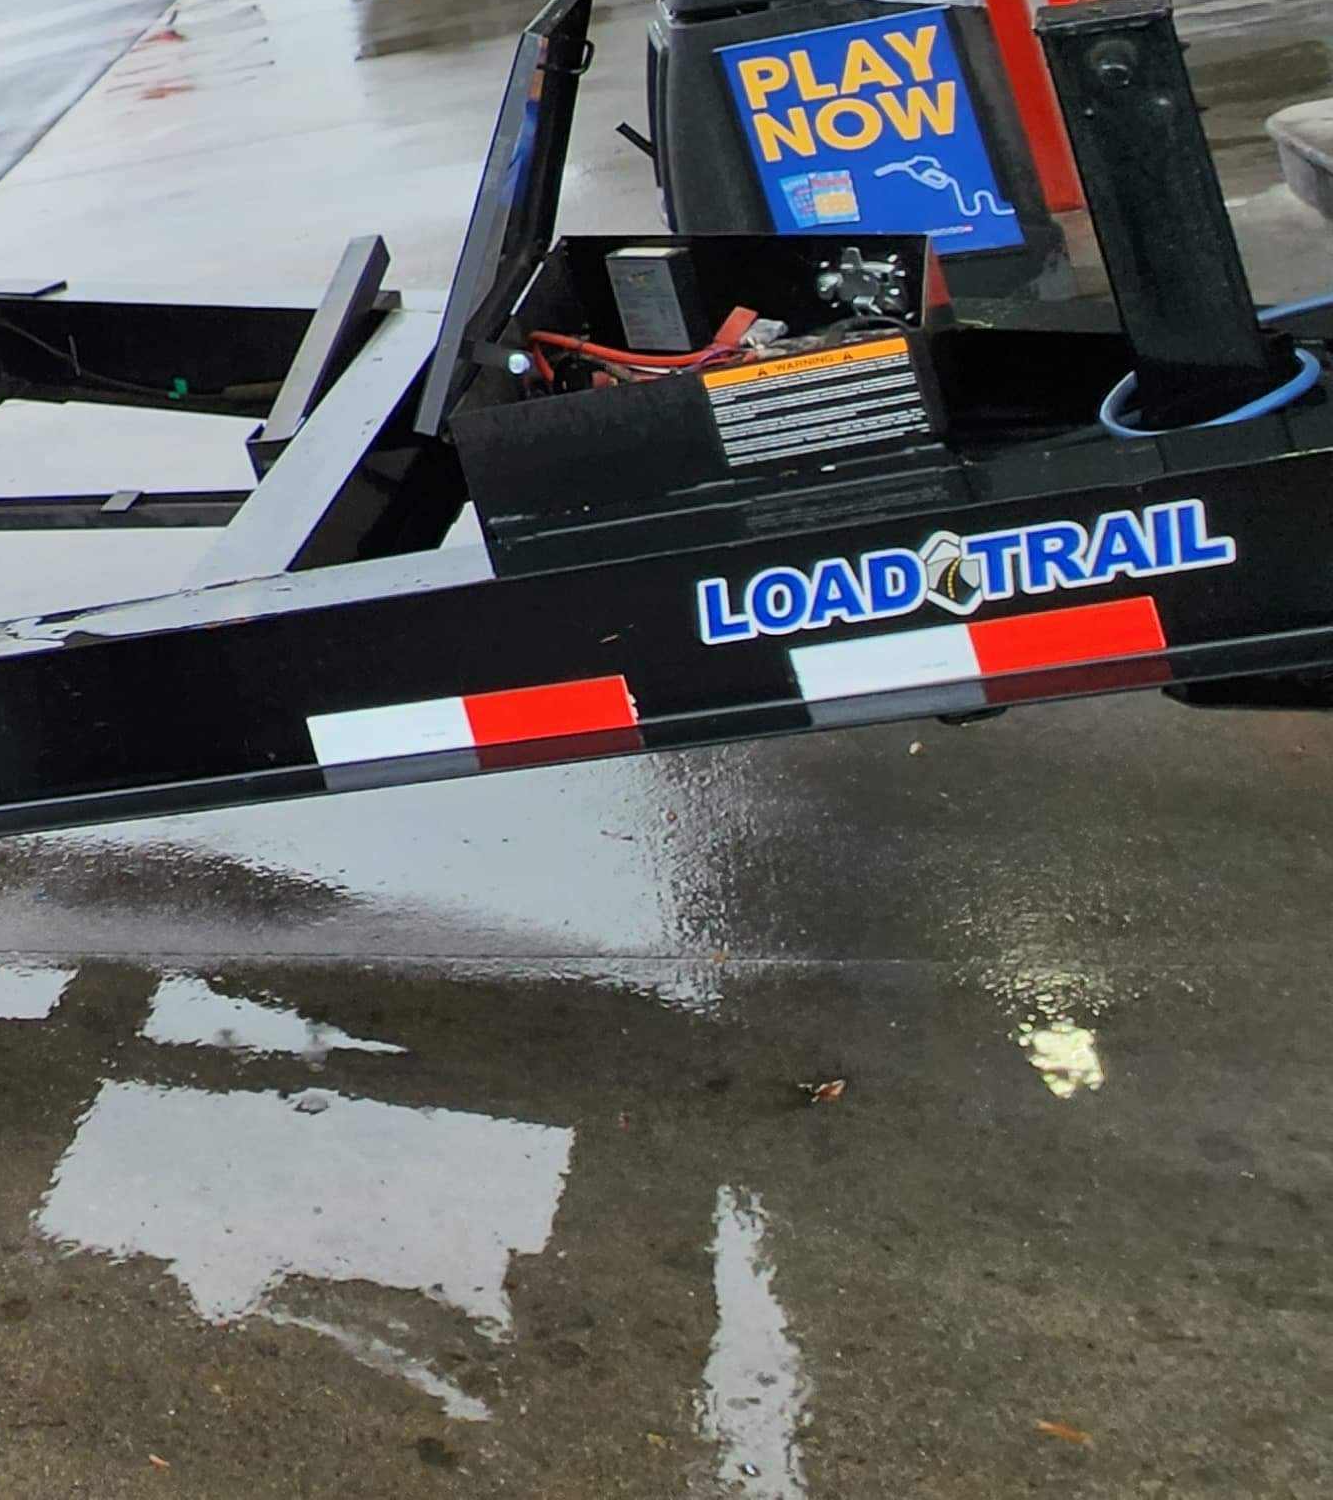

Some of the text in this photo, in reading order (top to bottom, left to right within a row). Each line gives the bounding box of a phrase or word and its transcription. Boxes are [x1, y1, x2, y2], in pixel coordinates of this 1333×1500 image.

[738, 25, 937, 110] PLAY
[753, 81, 955, 162] NOW
[775, 353, 834, 372] WARNING
[698, 499, 1236, 644] LOAD TRAIL
